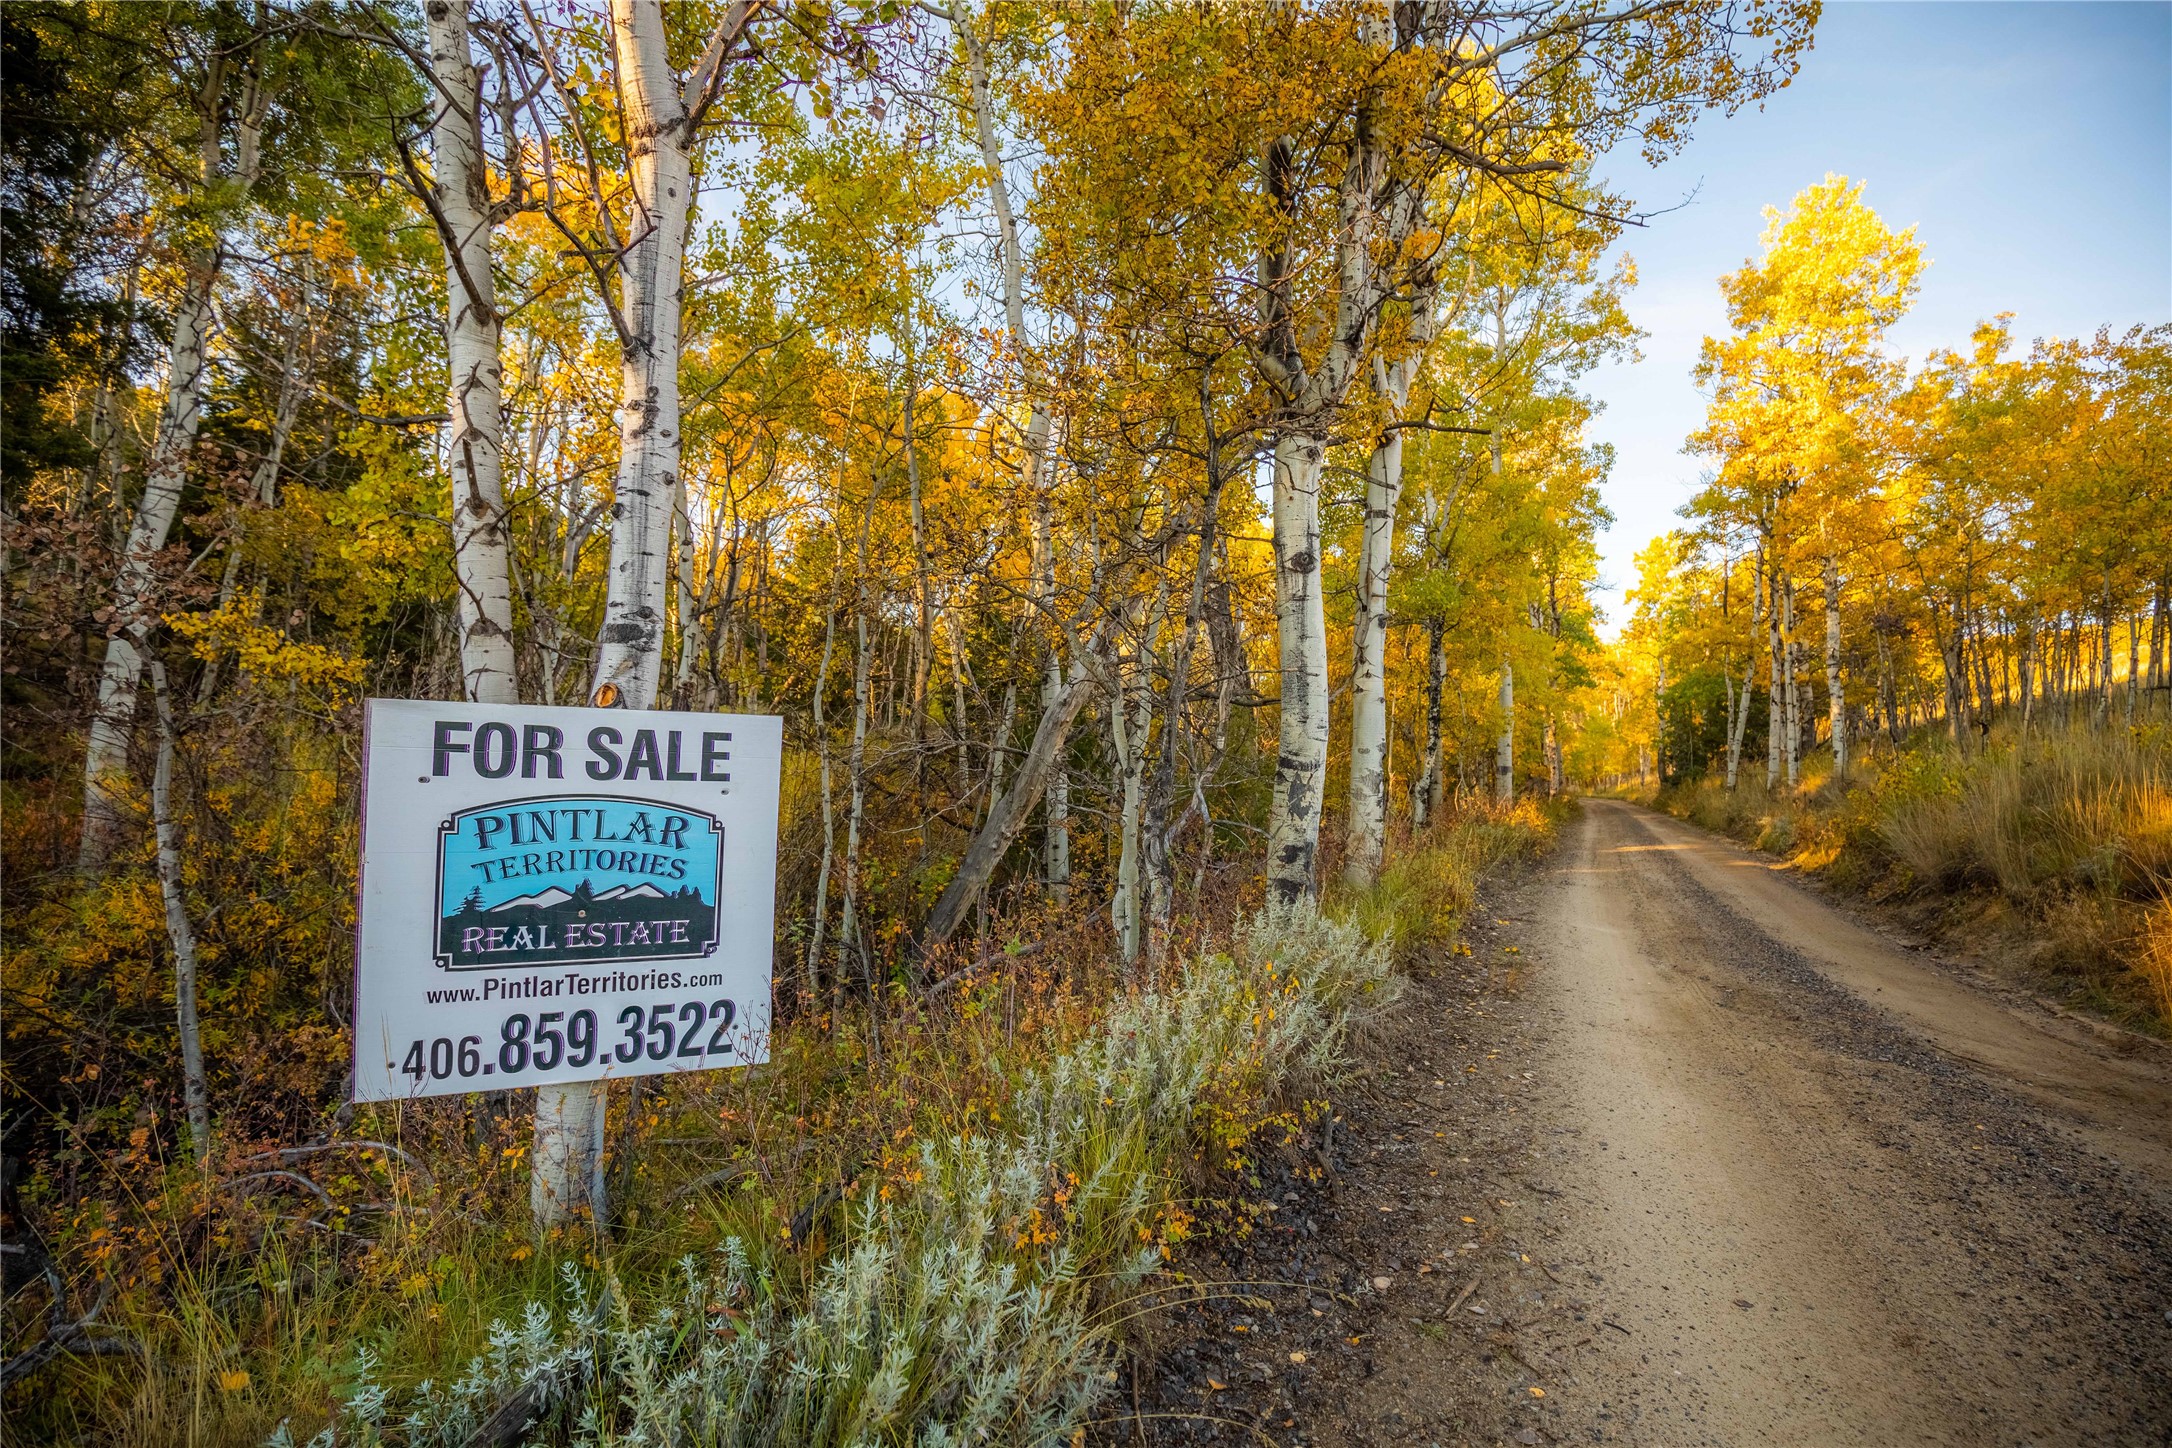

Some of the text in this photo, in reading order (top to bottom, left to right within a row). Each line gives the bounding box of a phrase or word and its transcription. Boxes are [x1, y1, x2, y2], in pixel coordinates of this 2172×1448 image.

[432, 720, 733, 782] FOR SALE
[473, 808, 691, 850] PINTLAR
[471, 849, 688, 884] TERRITORIES
[461, 919, 690, 954] REAL ESTATE
[426, 969, 723, 1004] www.PintlarTerritories.com
[402, 998, 737, 1080] 406.859.3522
